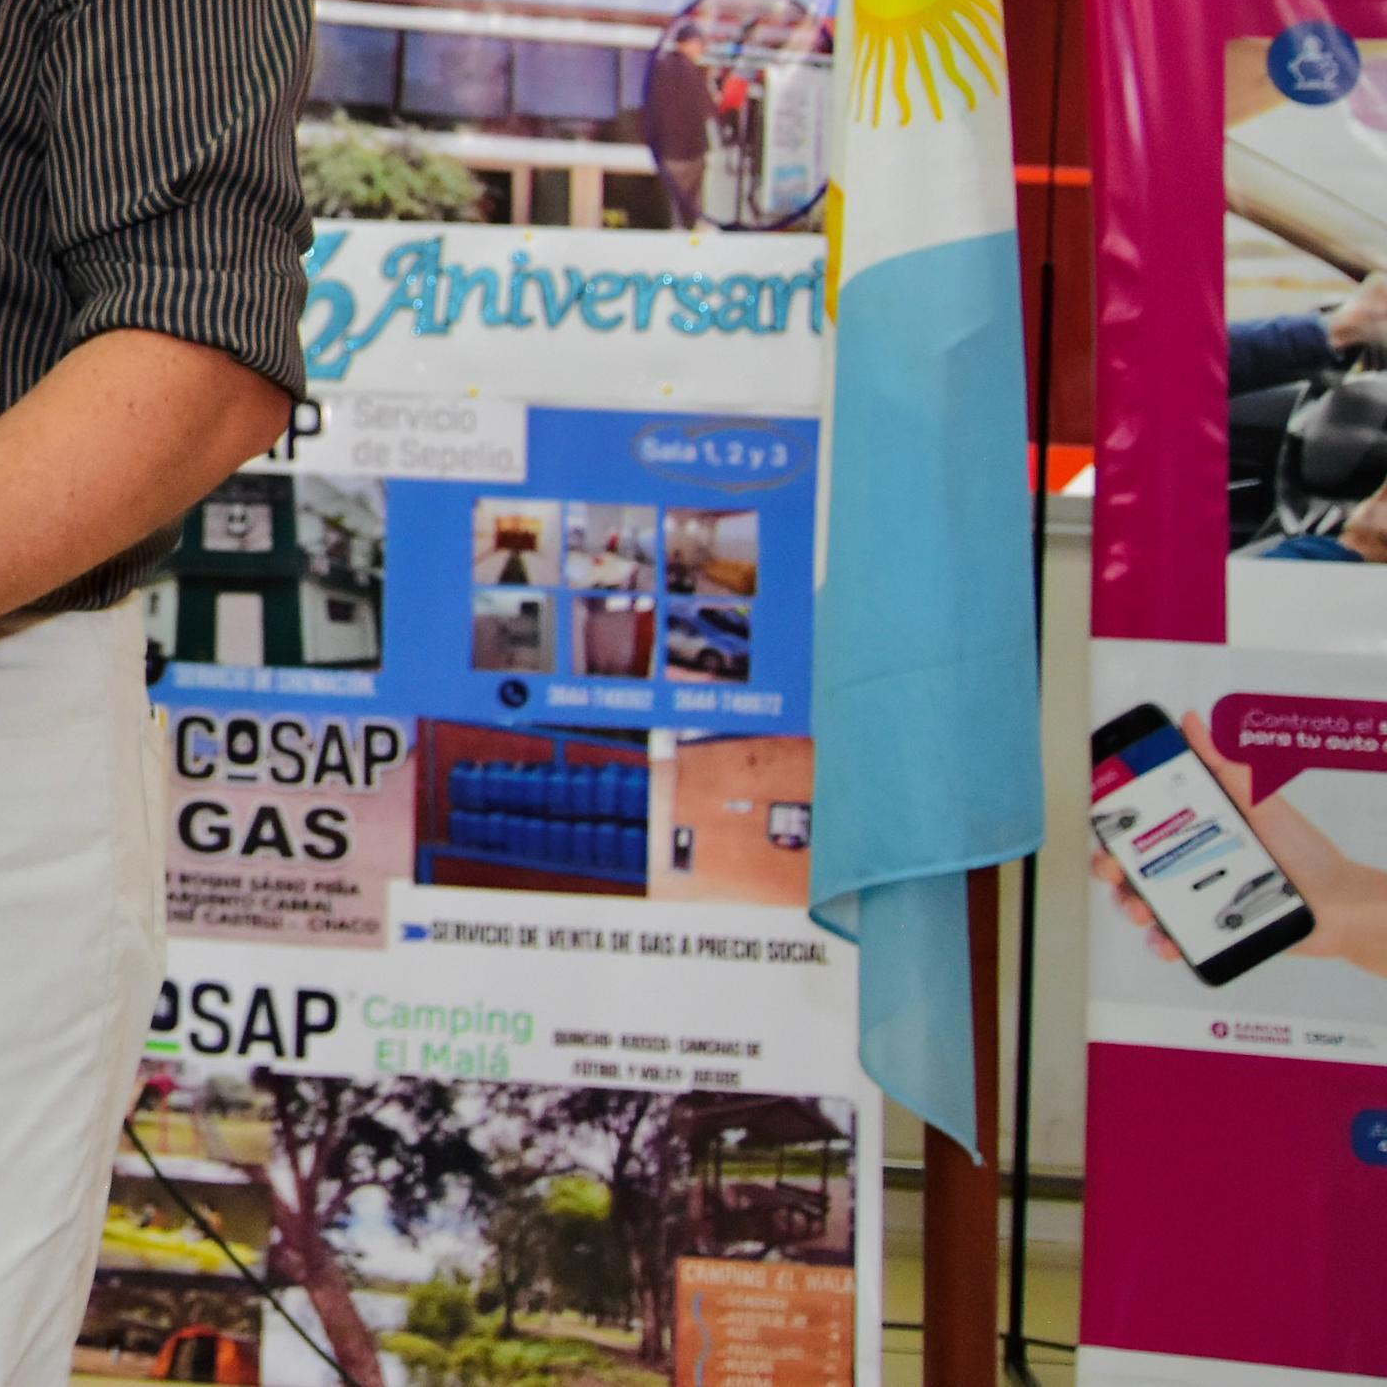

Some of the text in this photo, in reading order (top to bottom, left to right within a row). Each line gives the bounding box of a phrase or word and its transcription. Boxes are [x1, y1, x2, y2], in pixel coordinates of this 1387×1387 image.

[346, 234, 826, 351] Aniversari
[351, 394, 477, 434] Servicio
[351, 440, 391, 468] de
[177, 714, 400, 787] COSAP
[178, 801, 349, 861] GAS
[432, 919, 513, 947] SERVICIO
[519, 925, 539, 949] DE
[547, 927, 606, 952] VENTA
[611, 930, 633, 954] DE
[639, 932, 675, 957] GAS
[680, 935, 693, 958] A
[697, 936, 763, 963] PRECIO
[145, 980, 338, 1059] OSAP
[362, 995, 536, 1044] Camping
[374, 1039, 408, 1069] El
